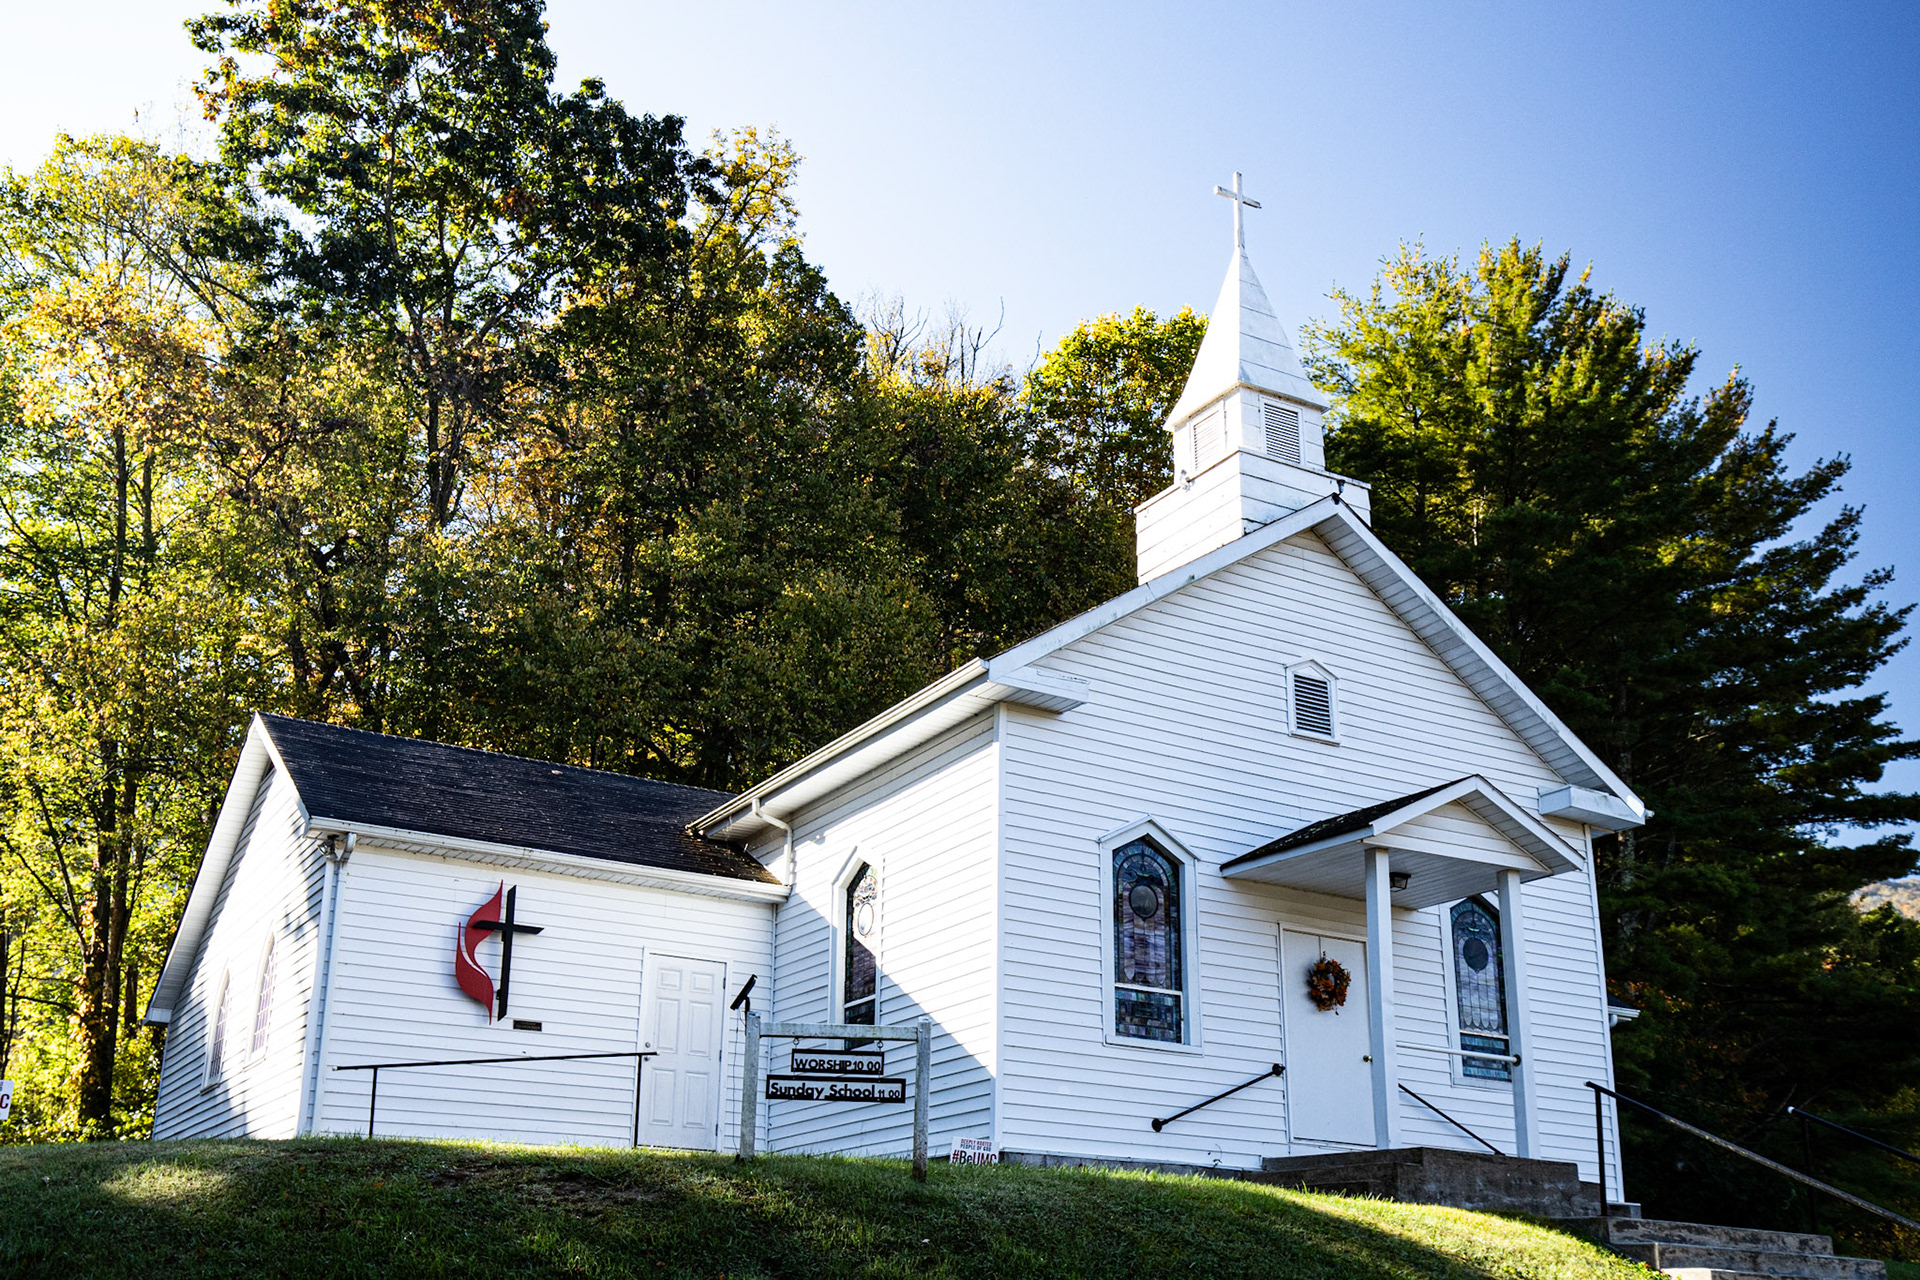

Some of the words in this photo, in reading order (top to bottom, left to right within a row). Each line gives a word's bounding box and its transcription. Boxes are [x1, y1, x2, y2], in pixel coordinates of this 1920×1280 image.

[794, 1058, 852, 1070] WORSHIP
[853, 1060, 864, 1071] 10
[771, 1082, 825, 1099] Sunday
[829, 1083, 875, 1098] School
[878, 1089, 885, 1098] 11
[888, 1089, 900, 1098] 00
[951, 1149, 997, 1166] #BeUMC
